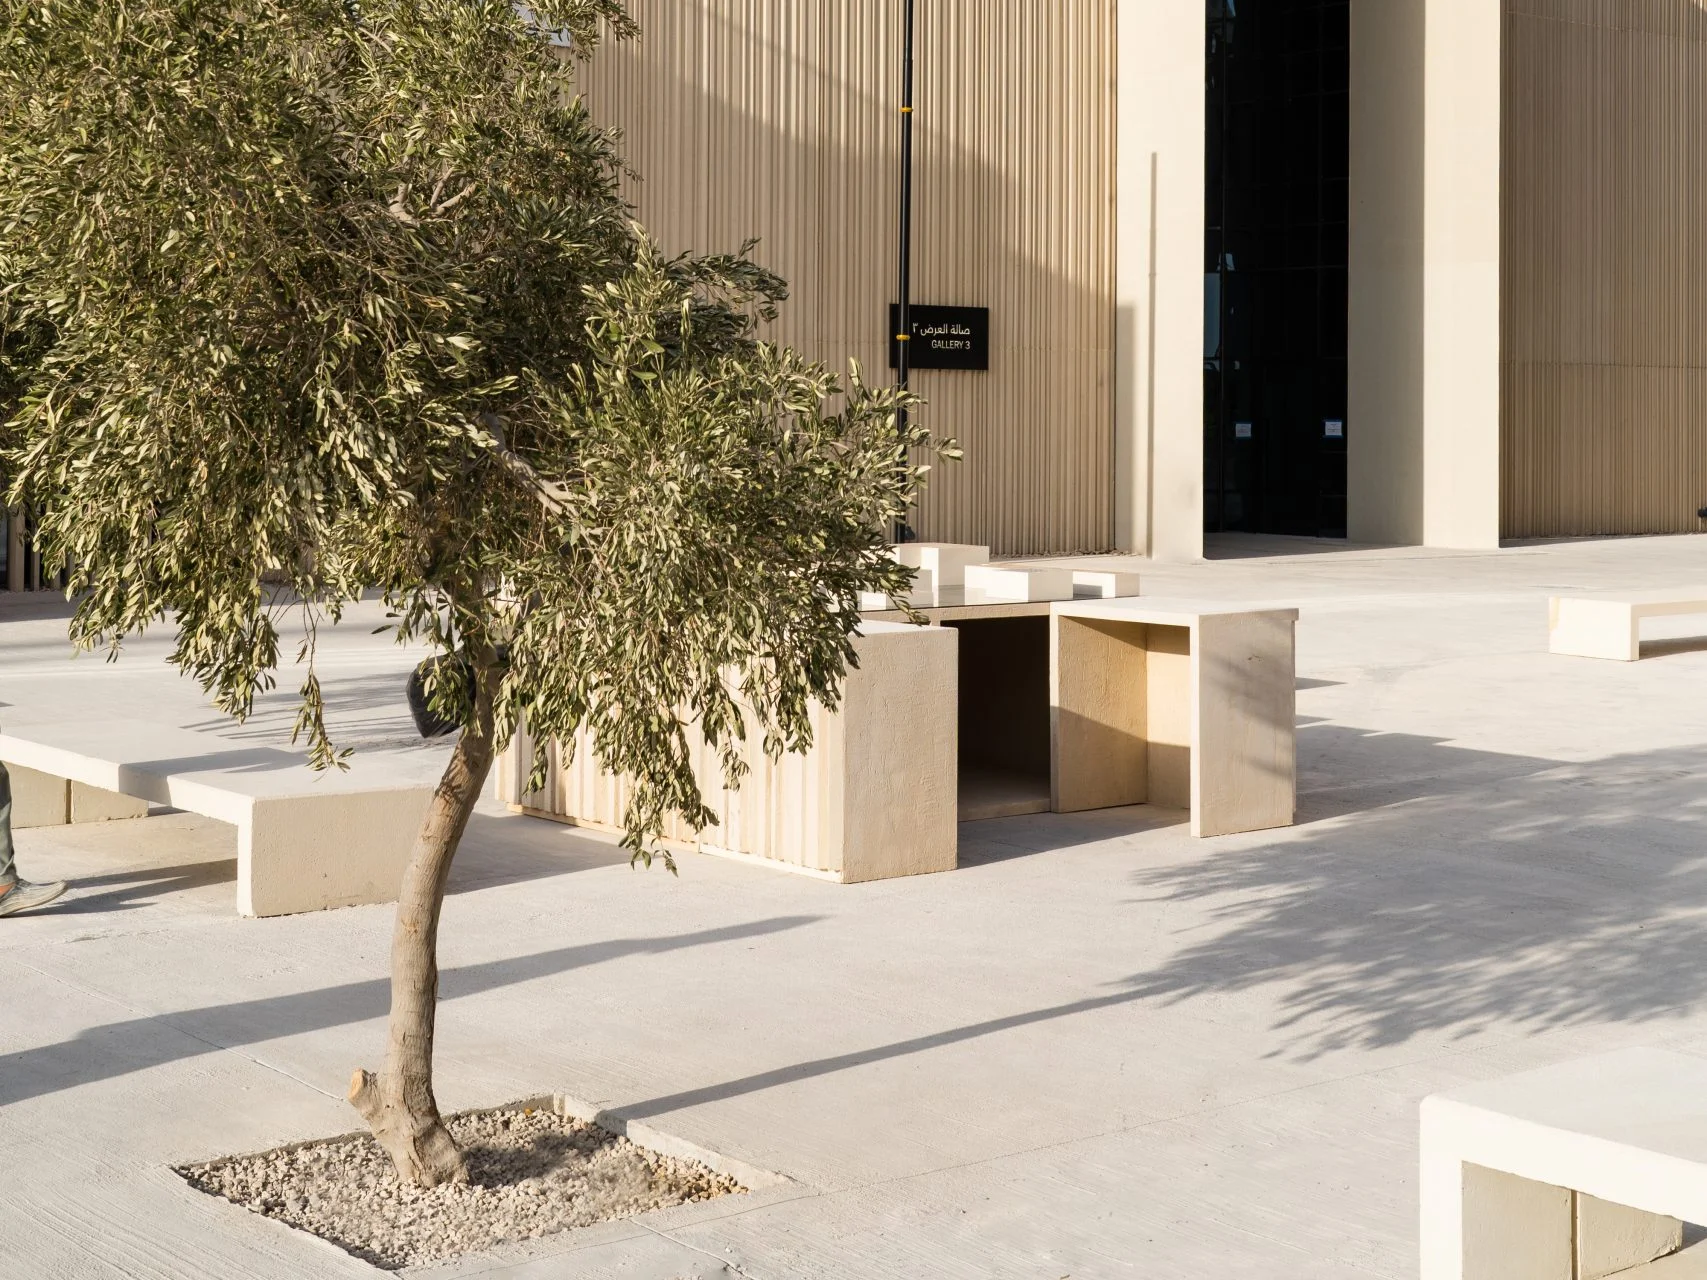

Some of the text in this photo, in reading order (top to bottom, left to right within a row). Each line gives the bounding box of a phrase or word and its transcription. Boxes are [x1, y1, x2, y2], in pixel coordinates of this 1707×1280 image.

[920, 323, 948, 336] العرض
[950, 323, 971, 335] صالة
[931, 339, 970, 349] GALLERY 3
